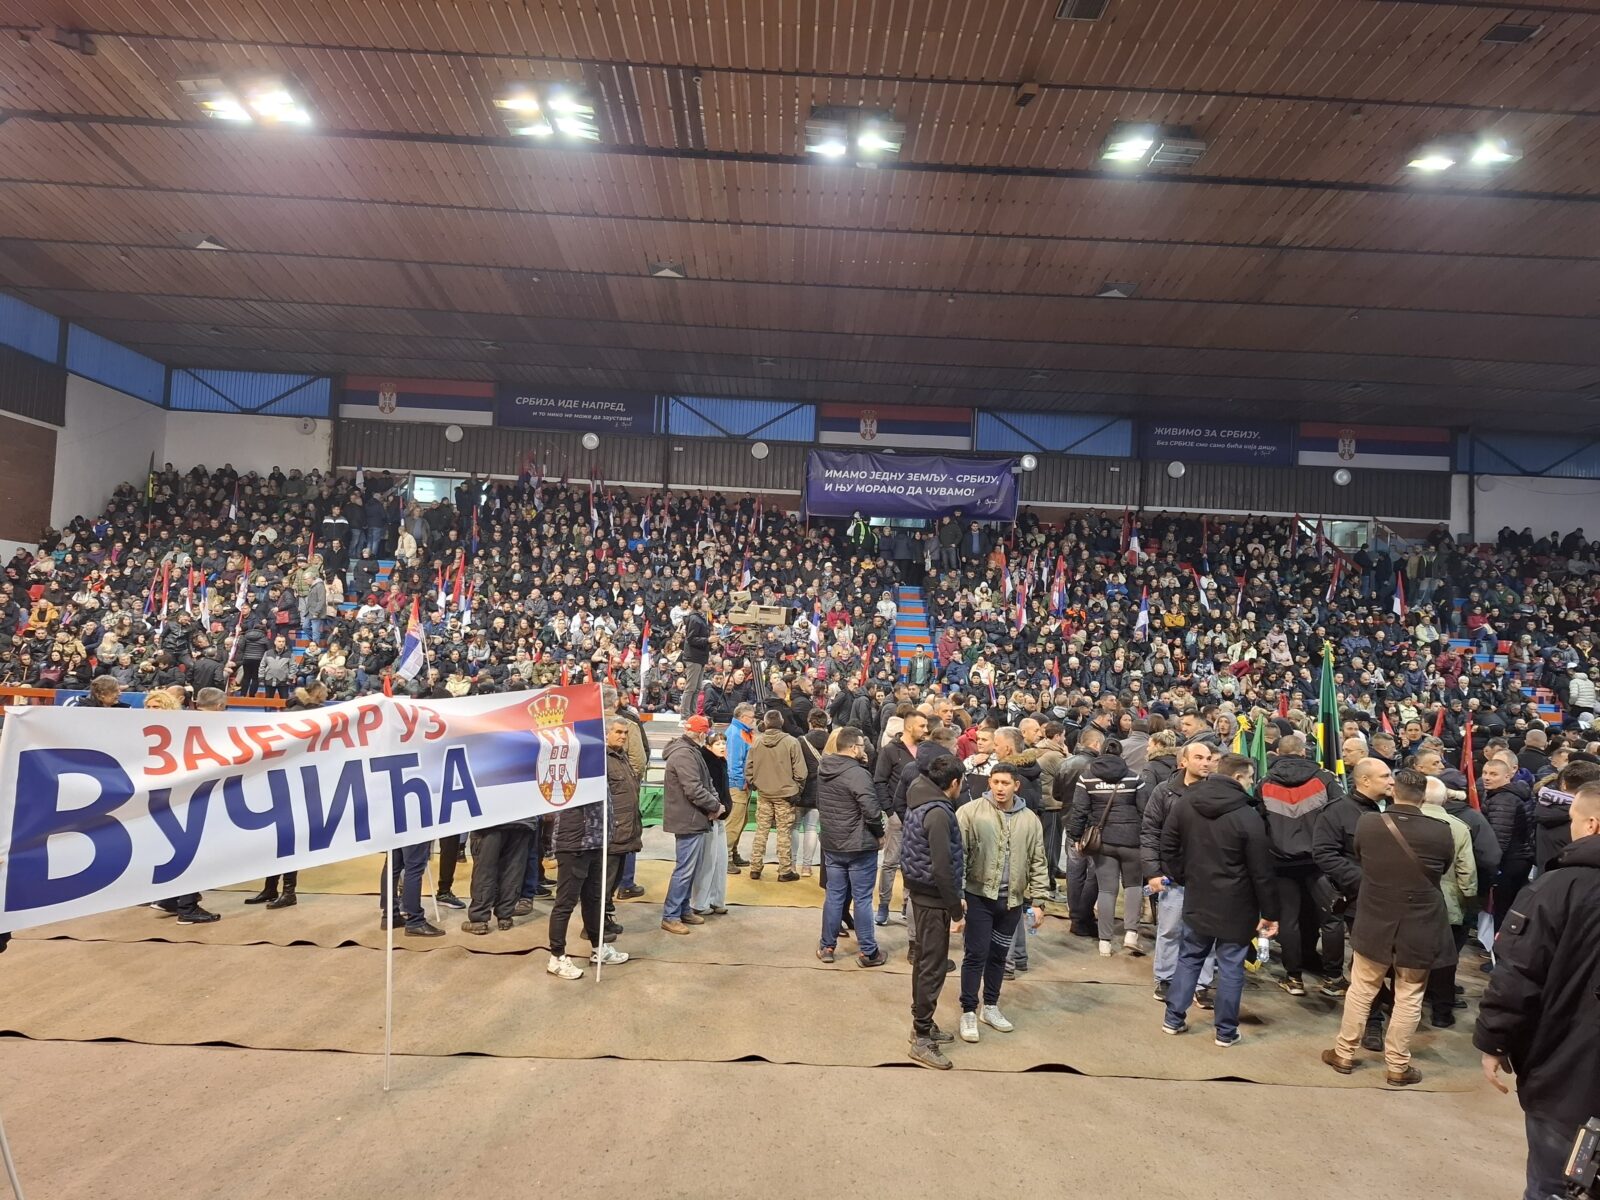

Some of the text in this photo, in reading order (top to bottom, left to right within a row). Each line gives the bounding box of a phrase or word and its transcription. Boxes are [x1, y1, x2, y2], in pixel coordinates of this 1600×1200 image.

[515, 396, 626, 412] СРБИЈА ИДЕ НАПРЕД,
[1154, 427, 1261, 440] ЖИВИМО ЗА СРБИЈУ.
[824, 469, 868, 480] ИМАМО
[869, 470, 905, 482] ЈЕДНУ
[906, 472, 948, 483] ЗЕМЉУ
[956, 474, 1000, 485] СРБИЈУ,
[824, 483, 975, 498] И ЊУ МОРАМО ДА ЧУВАМО!
[142, 700, 447, 776] ЗАЈЕЧАР УЗ
[5, 747, 483, 913] ВУЧИЋА
